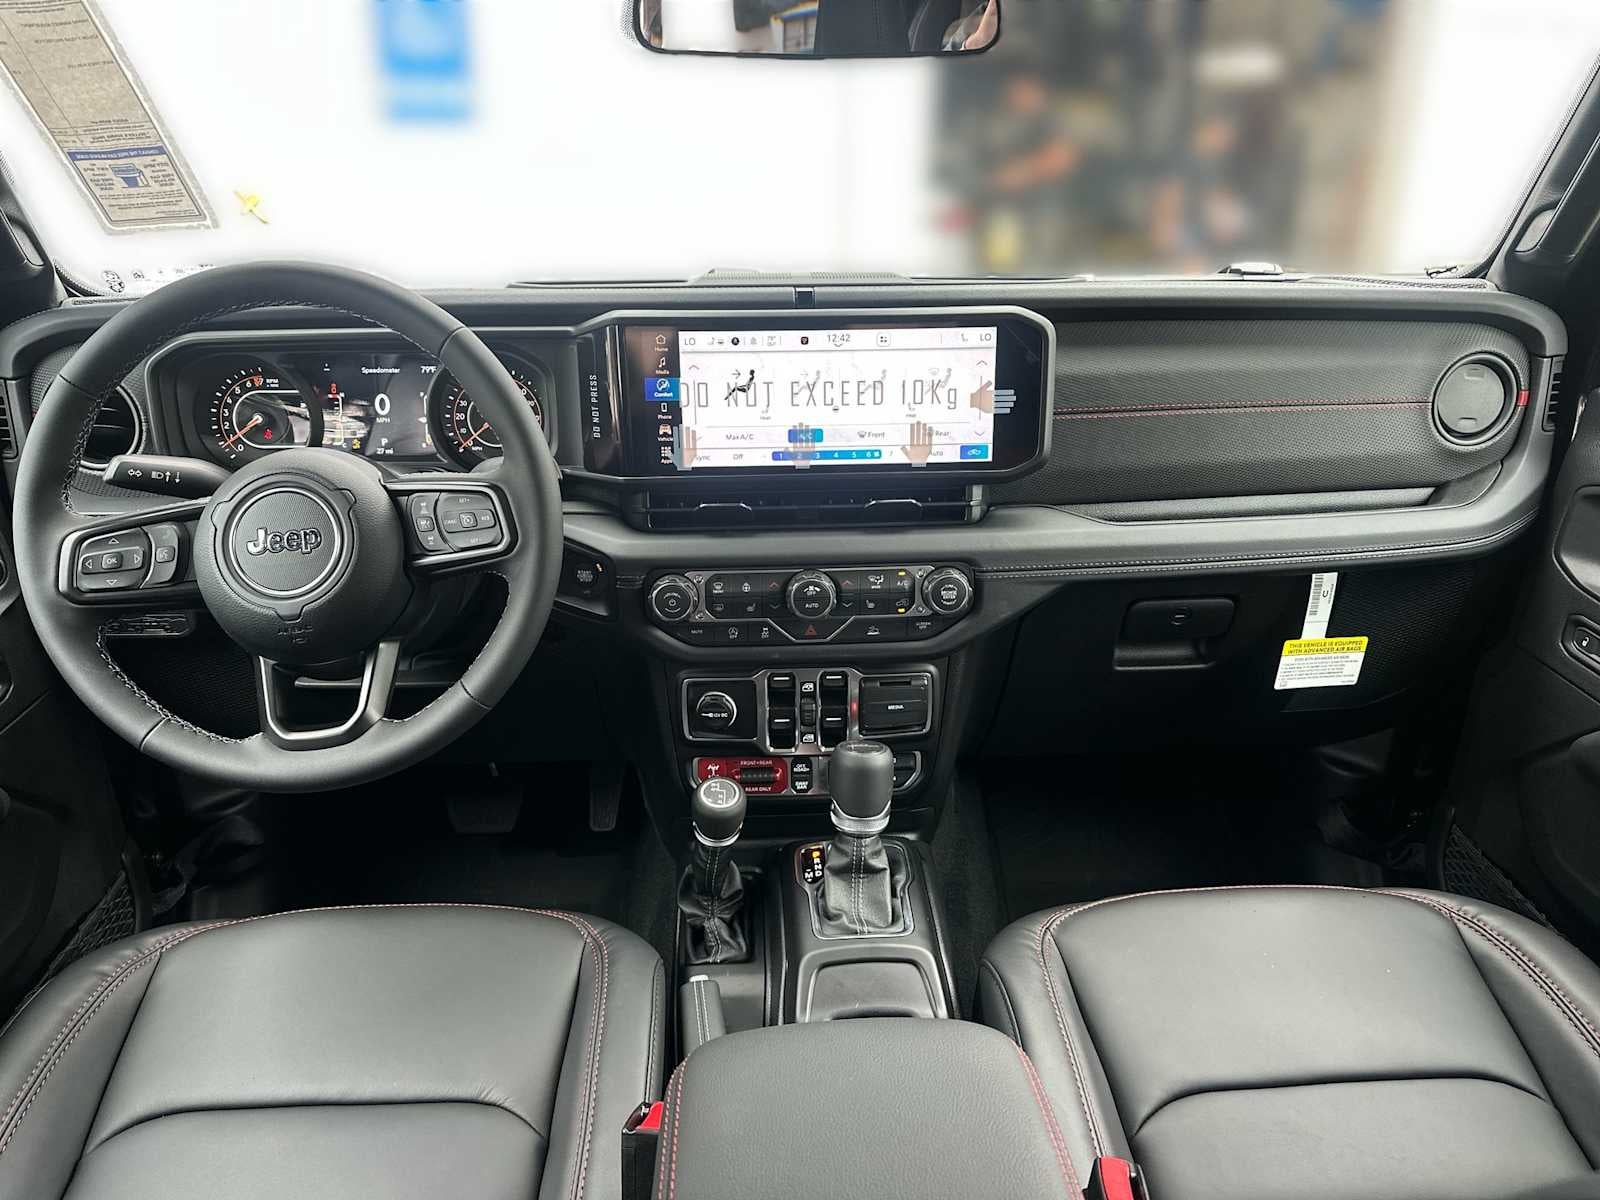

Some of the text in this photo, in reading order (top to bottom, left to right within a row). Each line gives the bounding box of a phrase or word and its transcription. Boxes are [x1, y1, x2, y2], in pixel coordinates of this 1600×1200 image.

[684, 337, 696, 346] LO
[826, 333, 851, 343] 12:42
[979, 333, 992, 342] LO
[361, 366, 401, 374] Speedometer
[246, 380, 252, 388] 6
[234, 386, 241, 395] 5
[726, 381, 774, 408] NOT
[790, 380, 885, 407] EXCEED
[226, 396, 233, 405] 4
[374, 392, 391, 416] 0
[459, 399, 468, 407] 30
[589, 374, 601, 439] DO NOT PRESS
[223, 408, 230, 417] 3
[455, 412, 466, 421] 20
[224, 422, 231, 430] 2
[867, 431, 886, 439] Front
[935, 430, 951, 438] Rear
[381, 438, 389, 447] P
[237, 443, 245, 452] 0
[733, 453, 744, 461] Off
[246, 527, 322, 556] Jeep
[106, 556, 118, 565] OK
[804, 871, 814, 879] M
